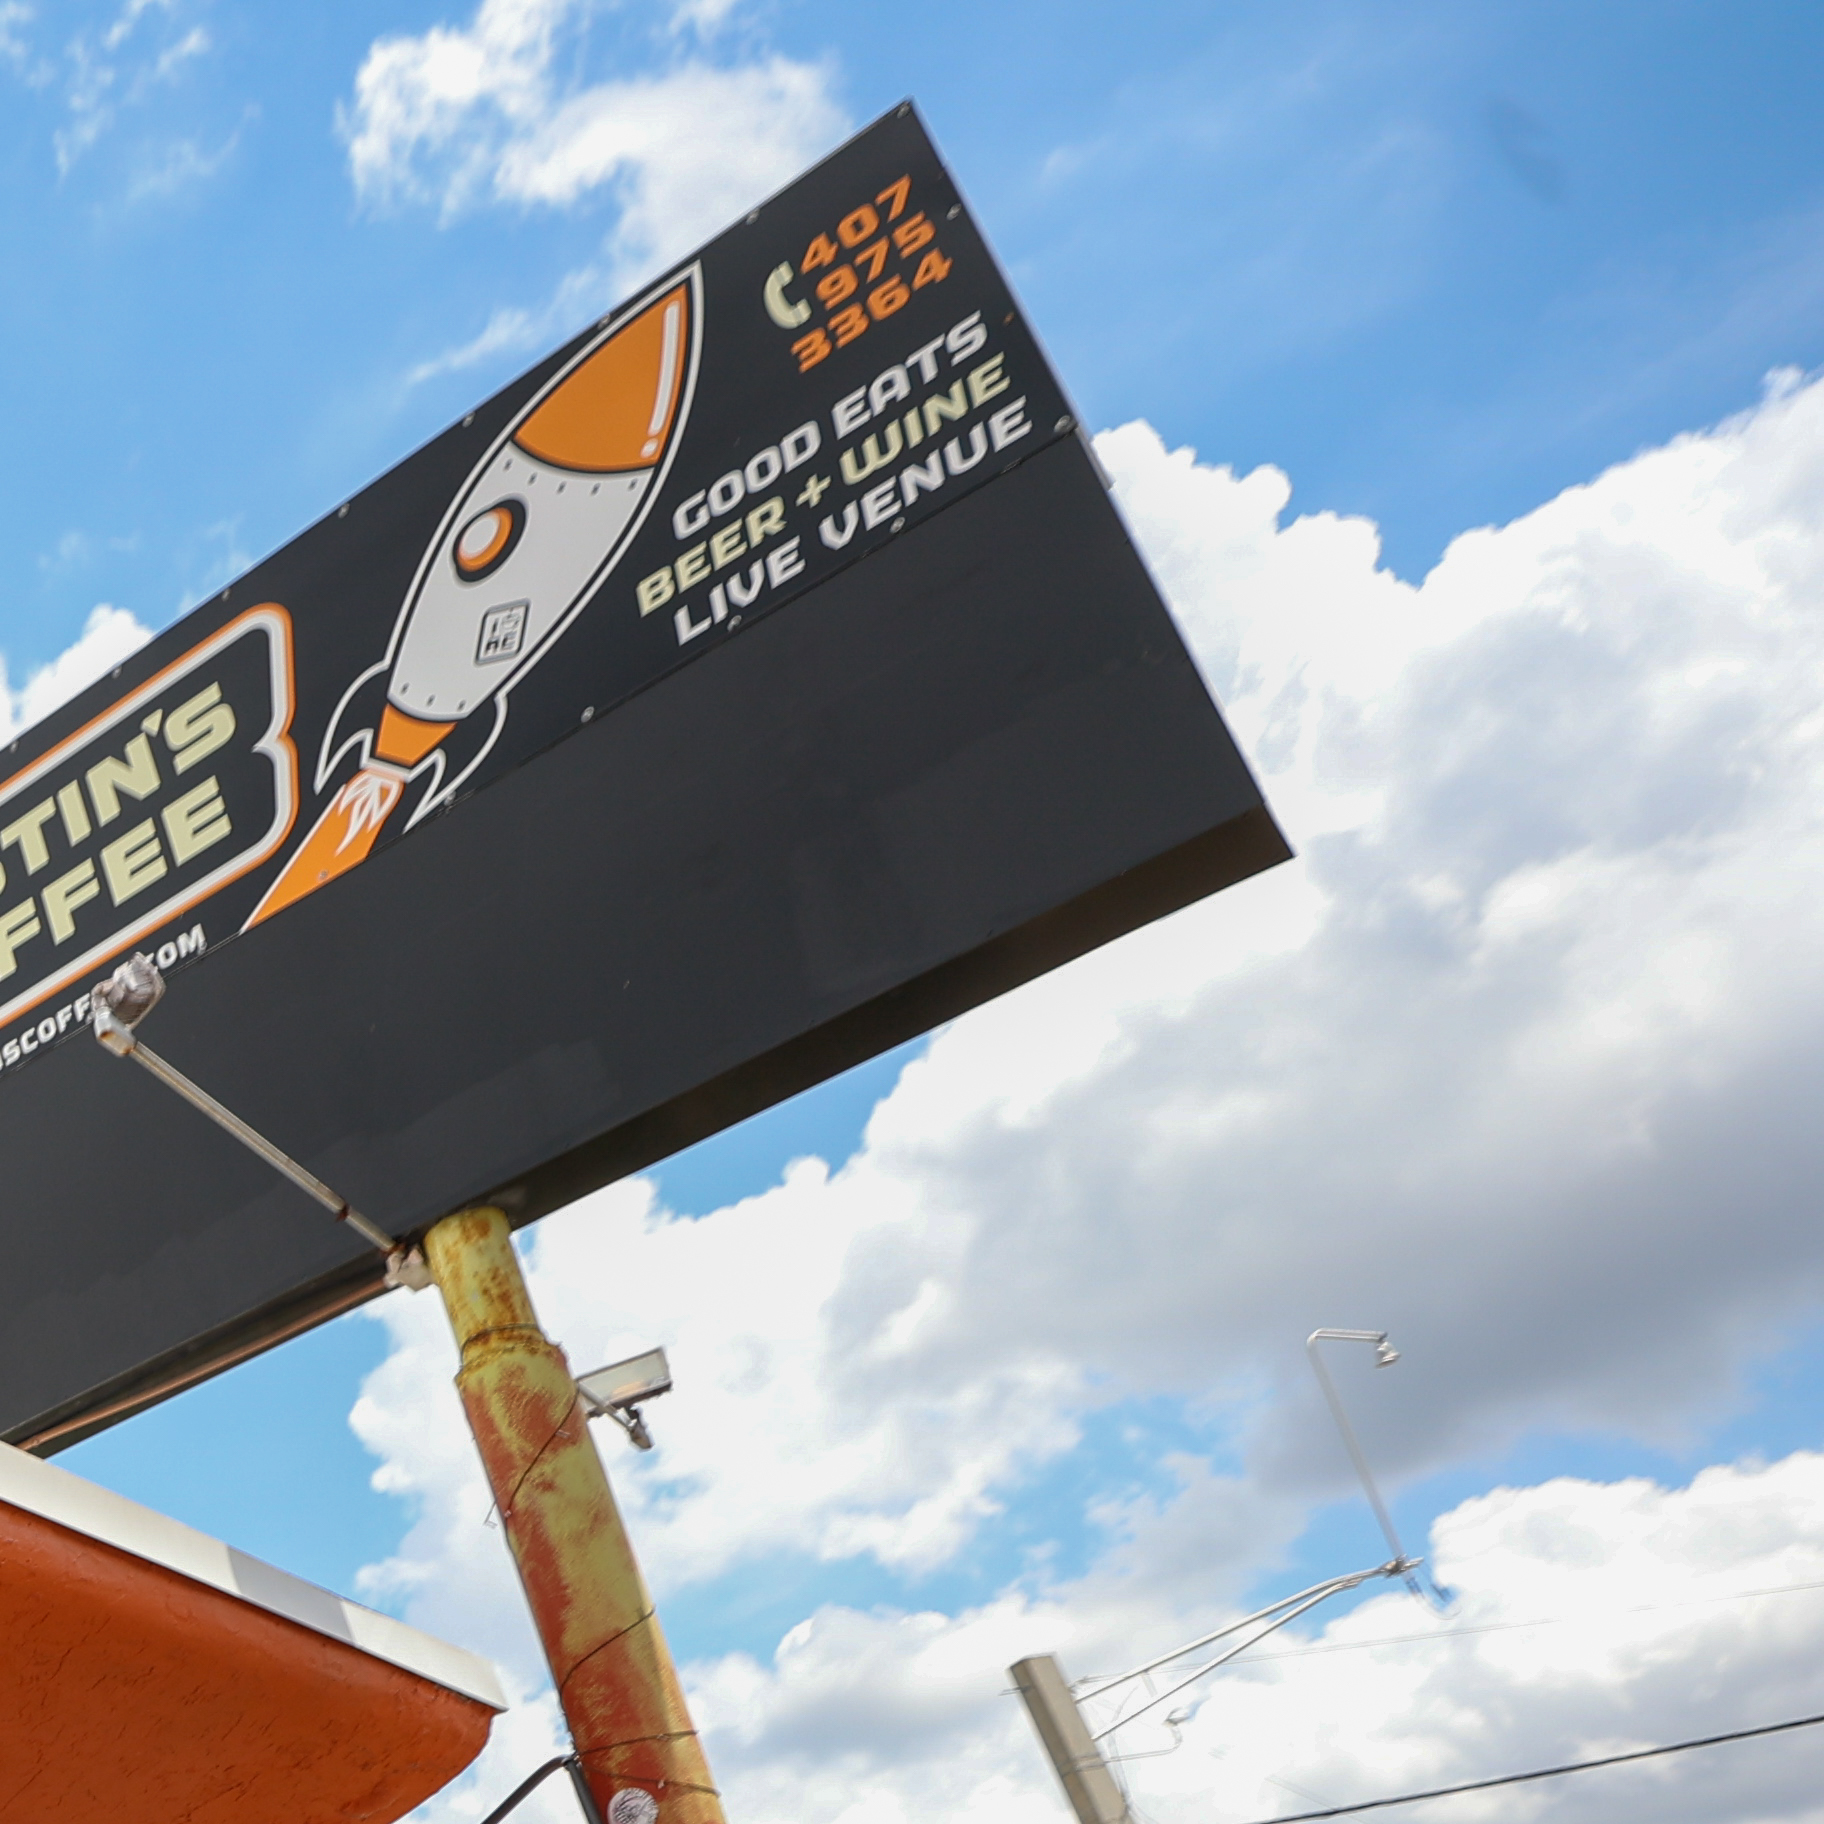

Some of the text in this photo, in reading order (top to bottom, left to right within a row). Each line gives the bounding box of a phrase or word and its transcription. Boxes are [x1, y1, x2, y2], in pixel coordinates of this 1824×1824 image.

[791, 248, 952, 374] 3364
[800, 174, 911, 274] 407
[815, 211, 935, 311] 975
[636, 497, 786, 618] BEER
[839, 352, 1010, 485] WINE
[672, 310, 988, 540] GOOD EATS
[673, 396, 1032, 646] LIVE VENUE
